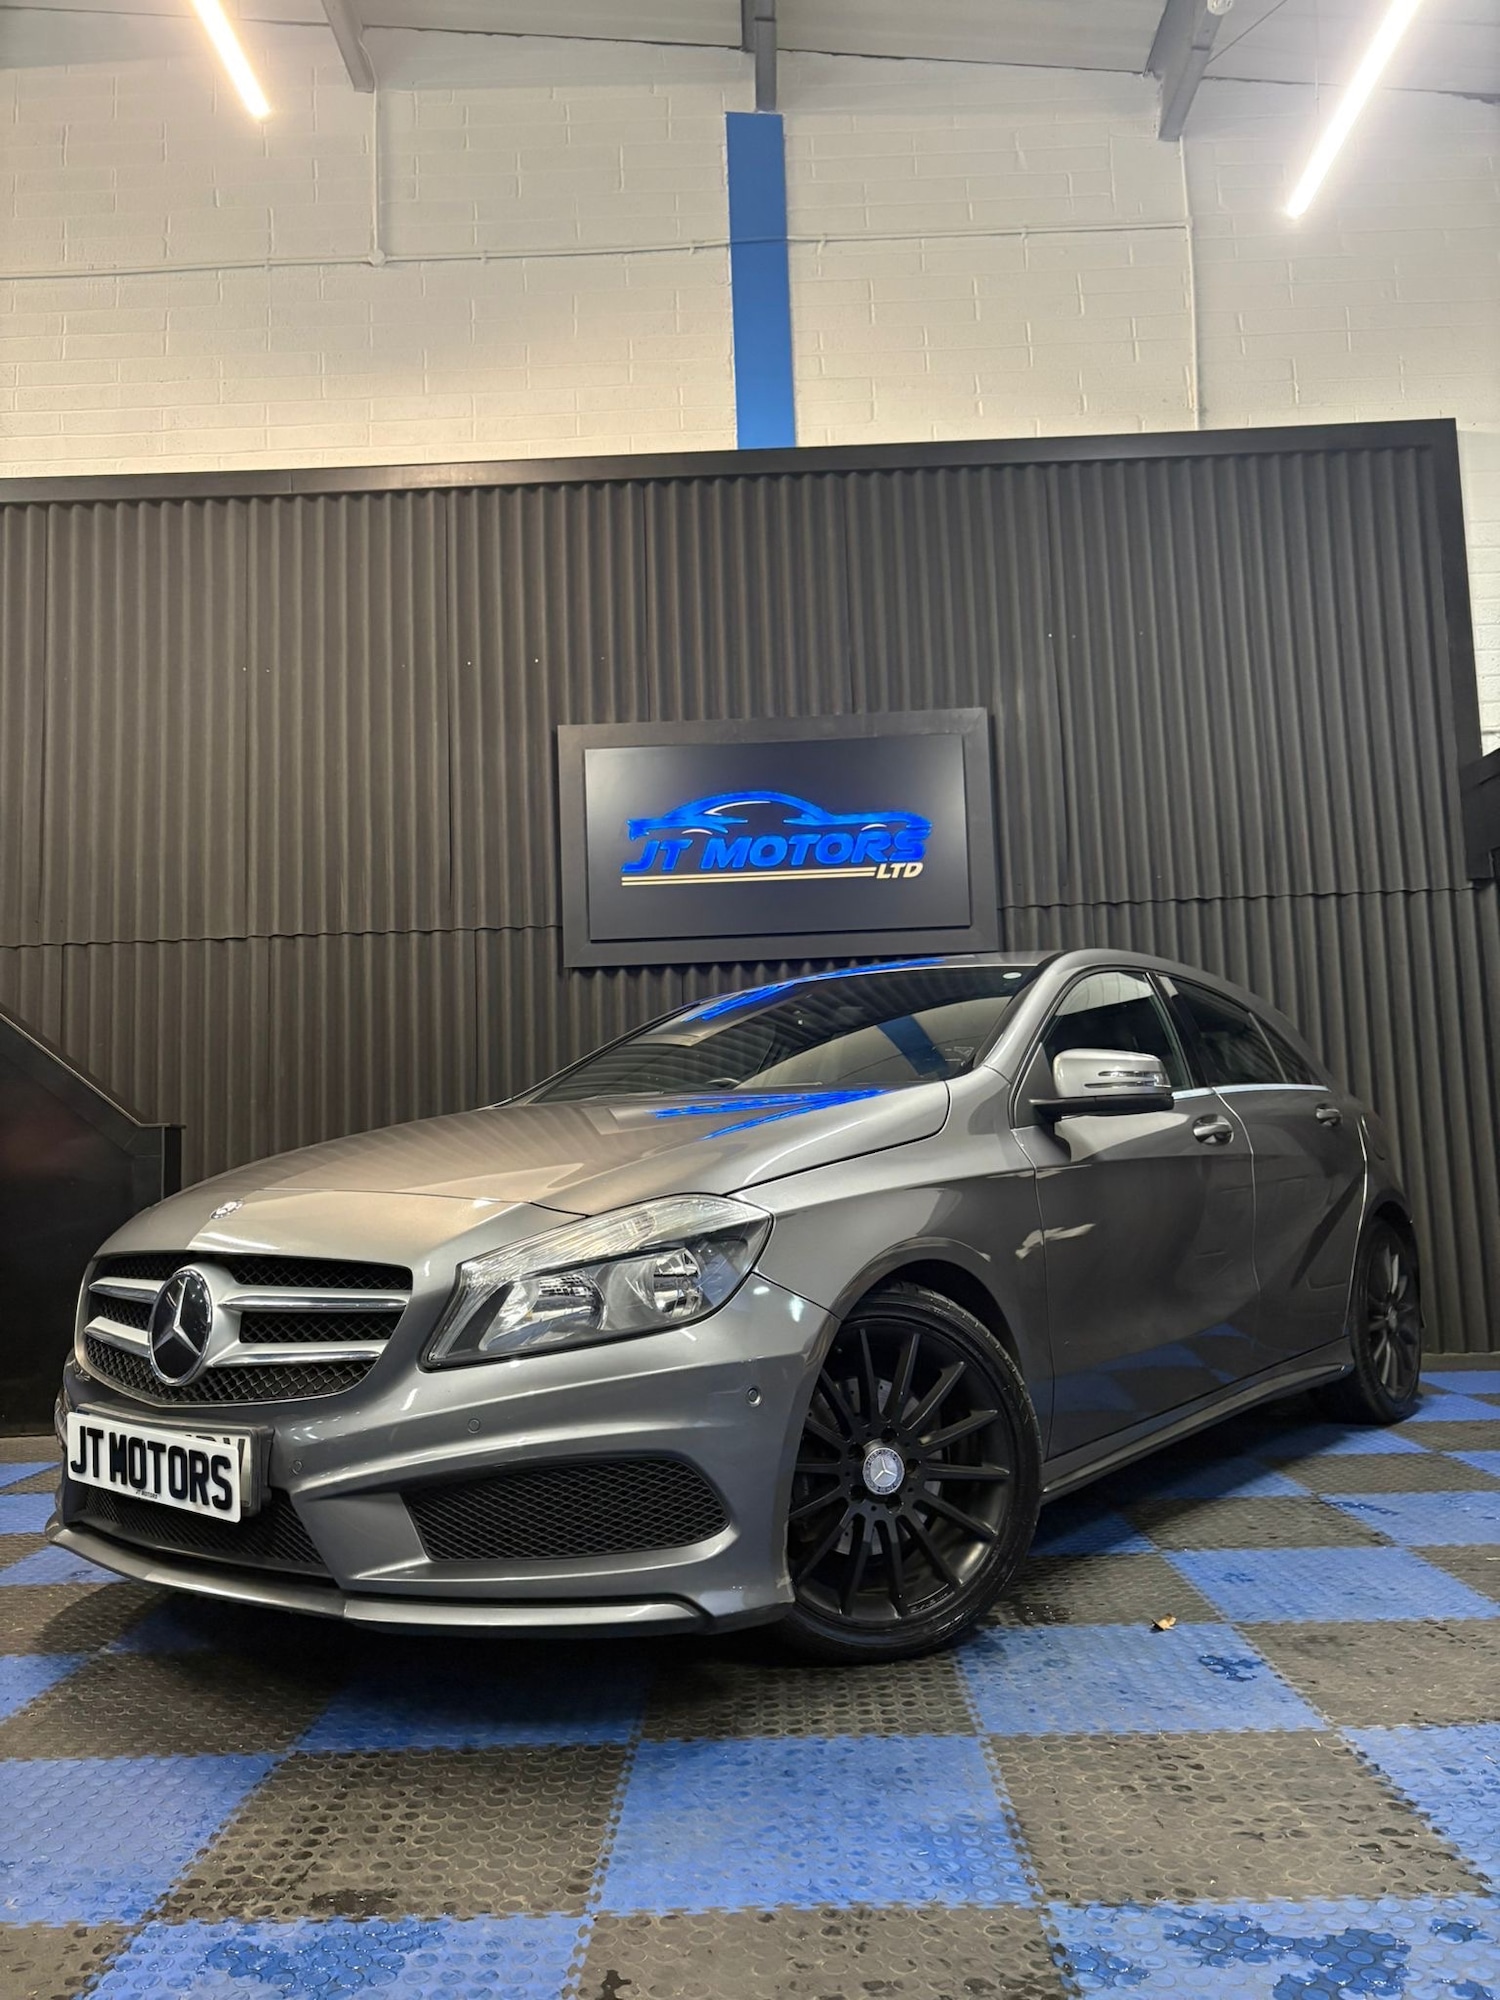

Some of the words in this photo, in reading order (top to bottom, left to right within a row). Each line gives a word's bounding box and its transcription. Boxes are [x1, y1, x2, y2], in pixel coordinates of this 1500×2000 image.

[621, 839, 693, 872] JT
[701, 831, 930, 870] MOTORS
[876, 862, 924, 880] LTD
[70, 1426, 104, 1478] JT
[109, 1432, 233, 1510] MOTORS
